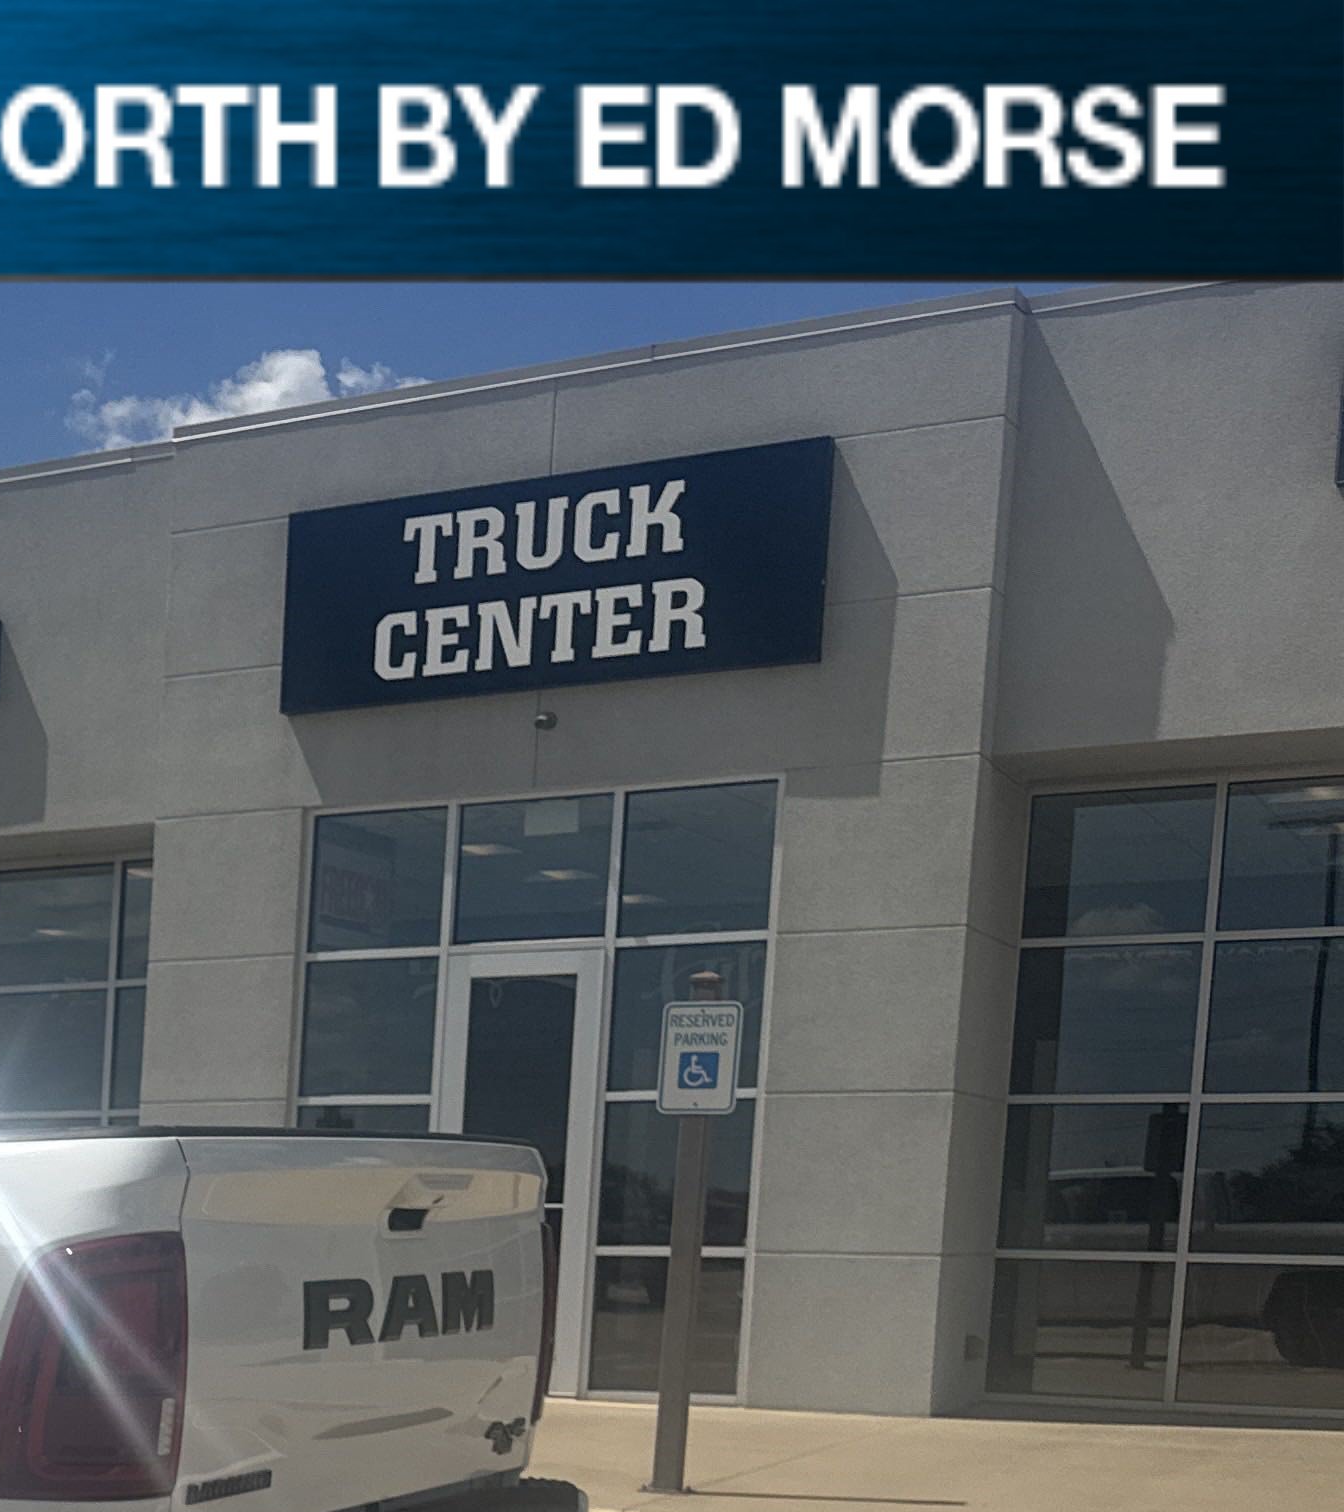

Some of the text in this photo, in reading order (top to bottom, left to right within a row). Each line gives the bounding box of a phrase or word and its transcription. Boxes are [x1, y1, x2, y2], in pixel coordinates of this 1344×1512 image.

[402, 478, 687, 585] TRUCK
[373, 576, 707, 682] CENTER
[669, 1012, 736, 1029] RESERVED
[673, 1031, 729, 1047] PARKING
[301, 1268, 496, 1352] RAM
